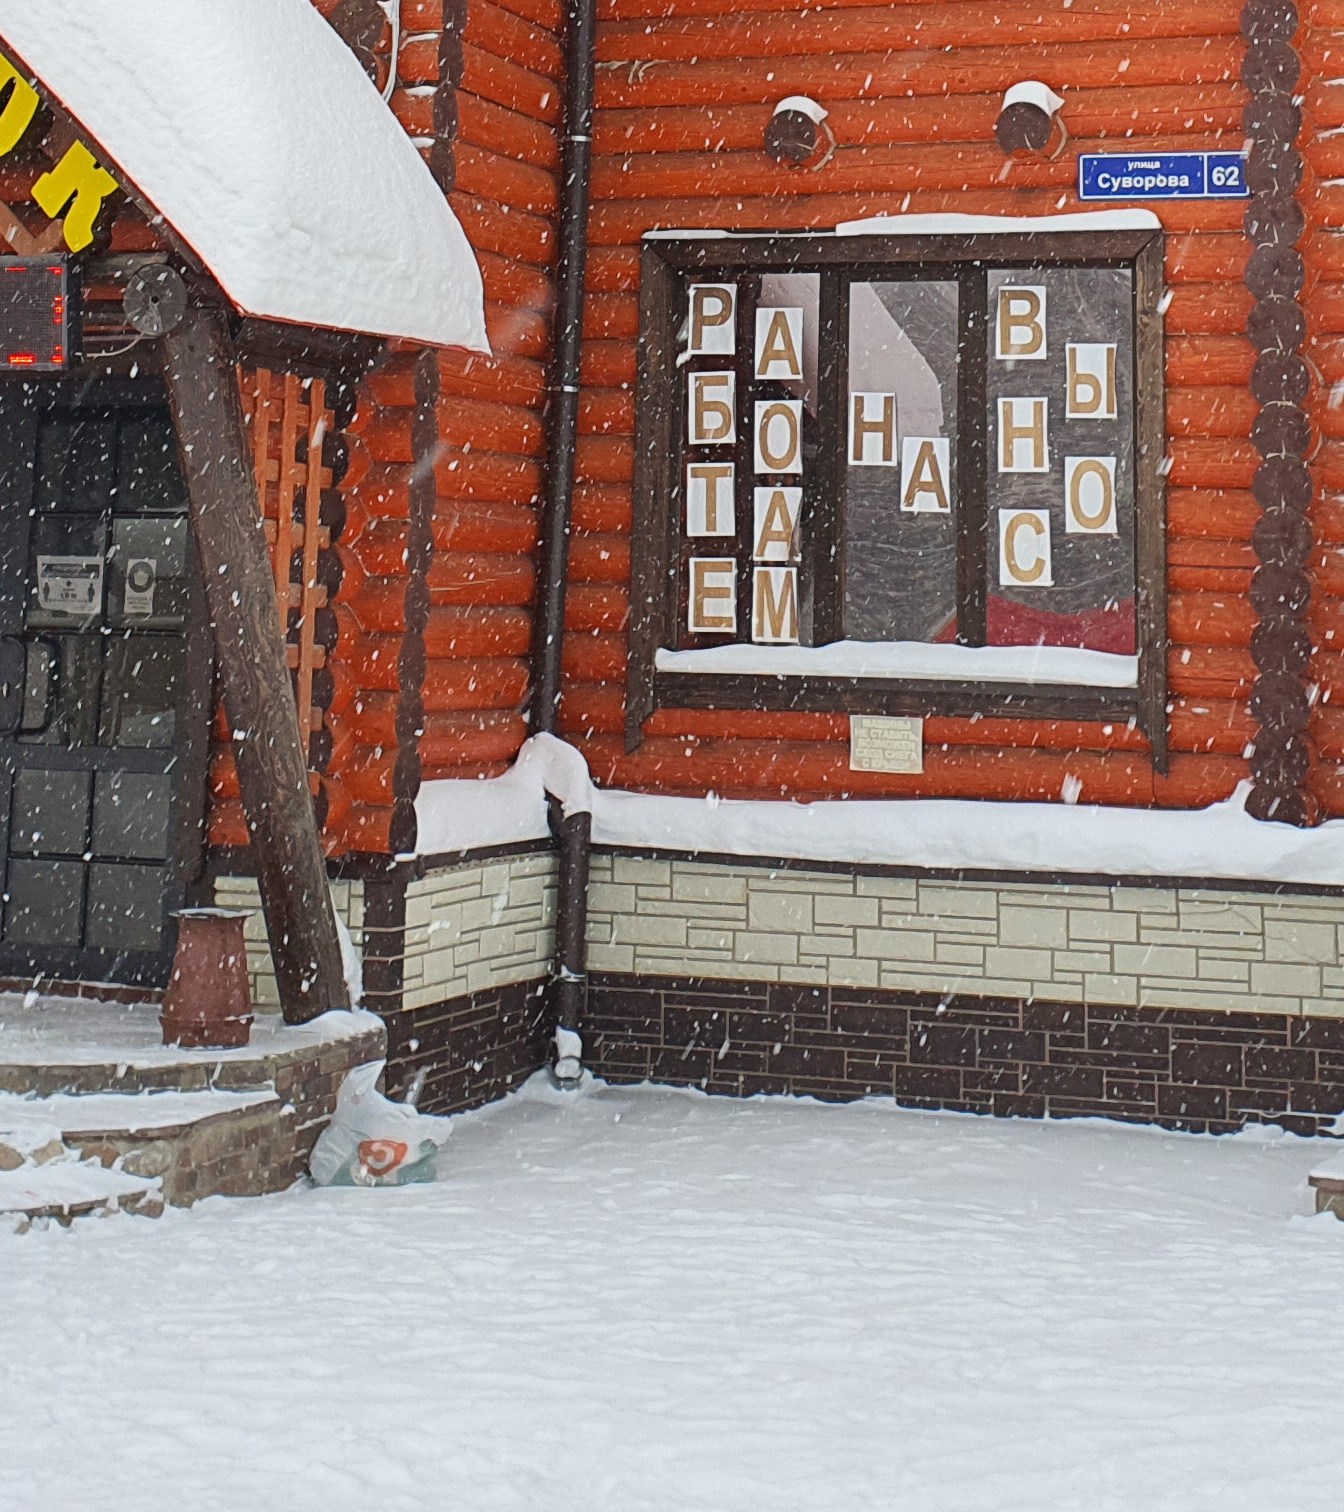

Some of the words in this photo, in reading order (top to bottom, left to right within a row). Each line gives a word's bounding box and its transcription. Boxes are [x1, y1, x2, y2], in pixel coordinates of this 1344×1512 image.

[1097, 172, 1190, 191] Суворова
[1211, 166, 1240, 186] 62
[1127, 159, 1161, 171] улица
[853, 394, 949, 509] НА
[998, 289, 1116, 583] ВЫНОС
